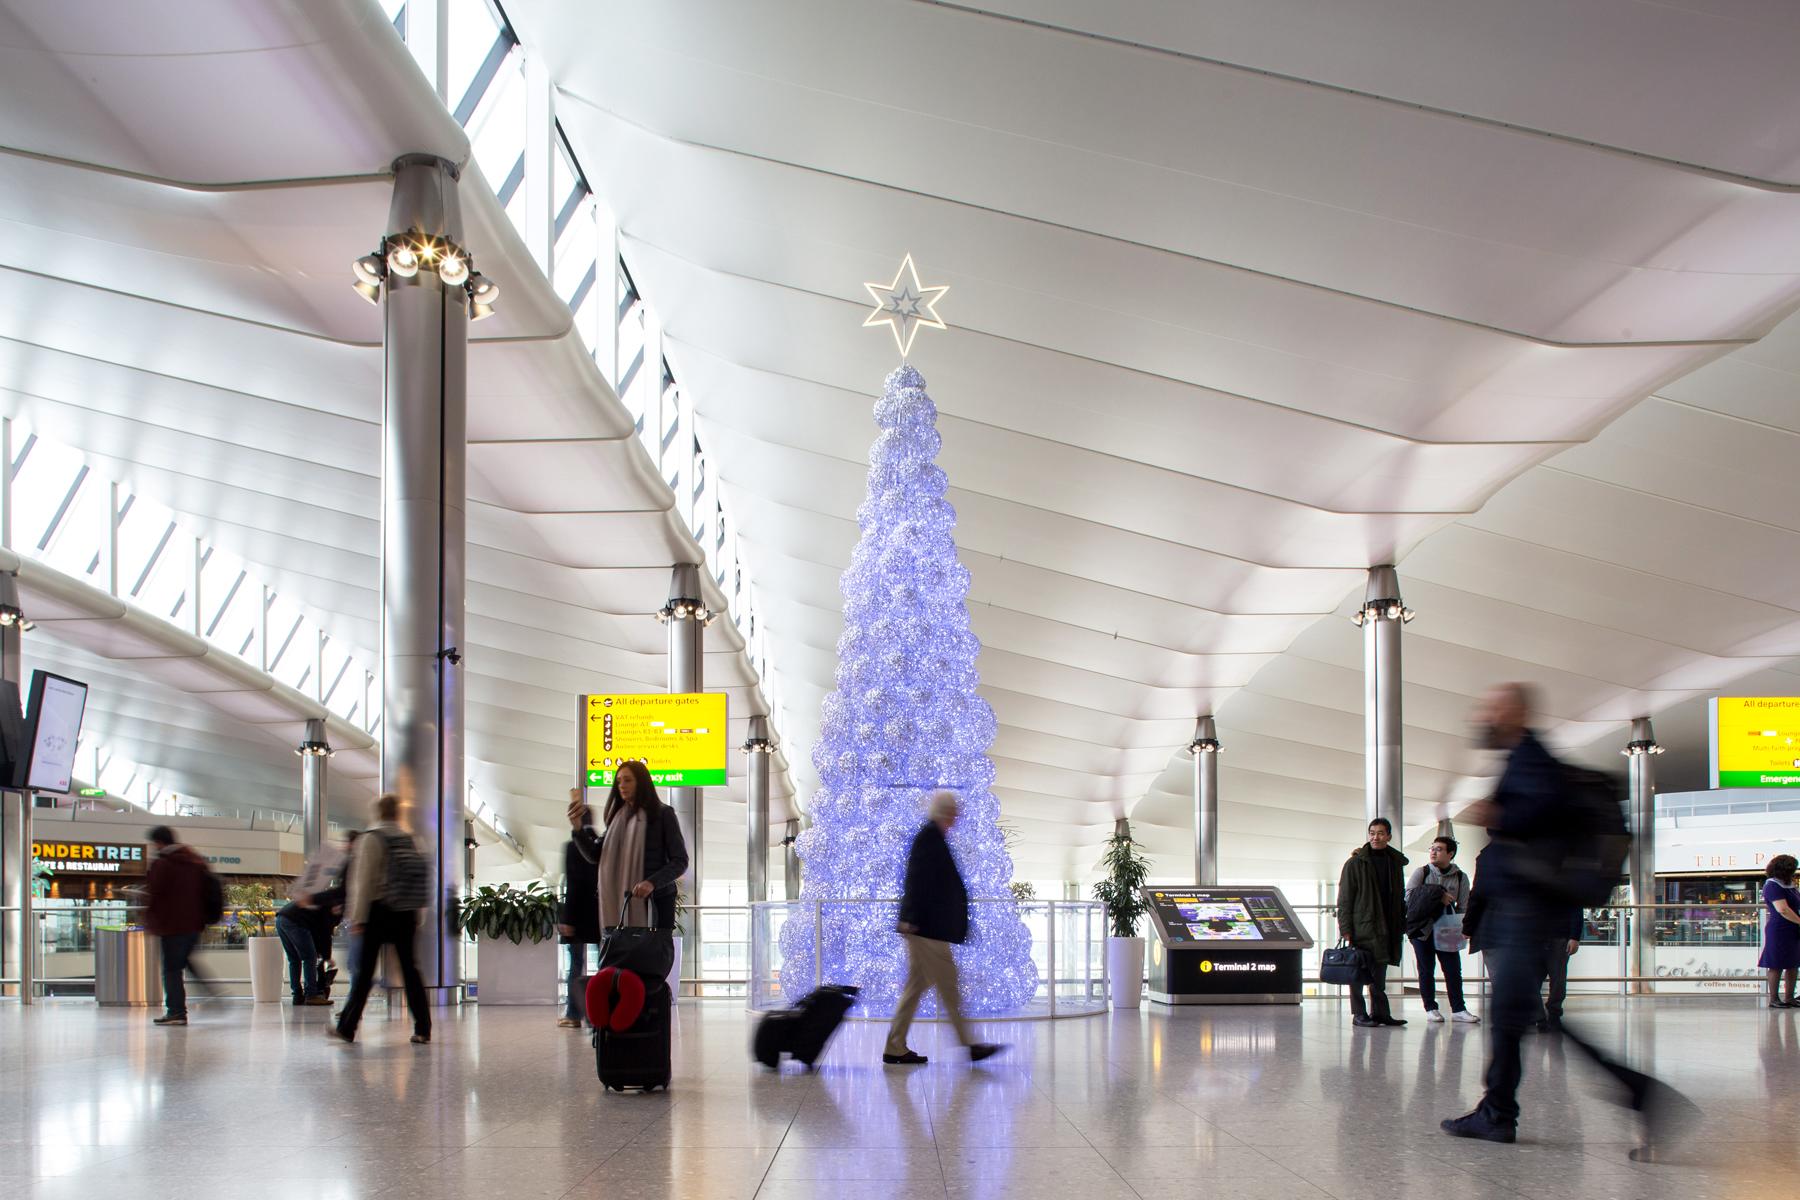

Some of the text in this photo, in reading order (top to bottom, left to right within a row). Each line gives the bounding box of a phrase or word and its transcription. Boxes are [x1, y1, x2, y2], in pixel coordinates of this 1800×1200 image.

[628, 698, 674, 707] departure
[675, 697, 700, 706] gates
[1743, 700, 1755, 708] All
[685, 735, 698, 743] Spa
[665, 772, 683, 781] exit
[219, 856, 241, 865] FOOD
[1694, 855, 1737, 867] THE
[57, 862, 65, 870] &
[65, 861, 121, 872] RESTAURANT
[1213, 962, 1276, 972] Terminal 2 map
[1703, 980, 1726, 988] coffee
[1728, 981, 1751, 989] house
